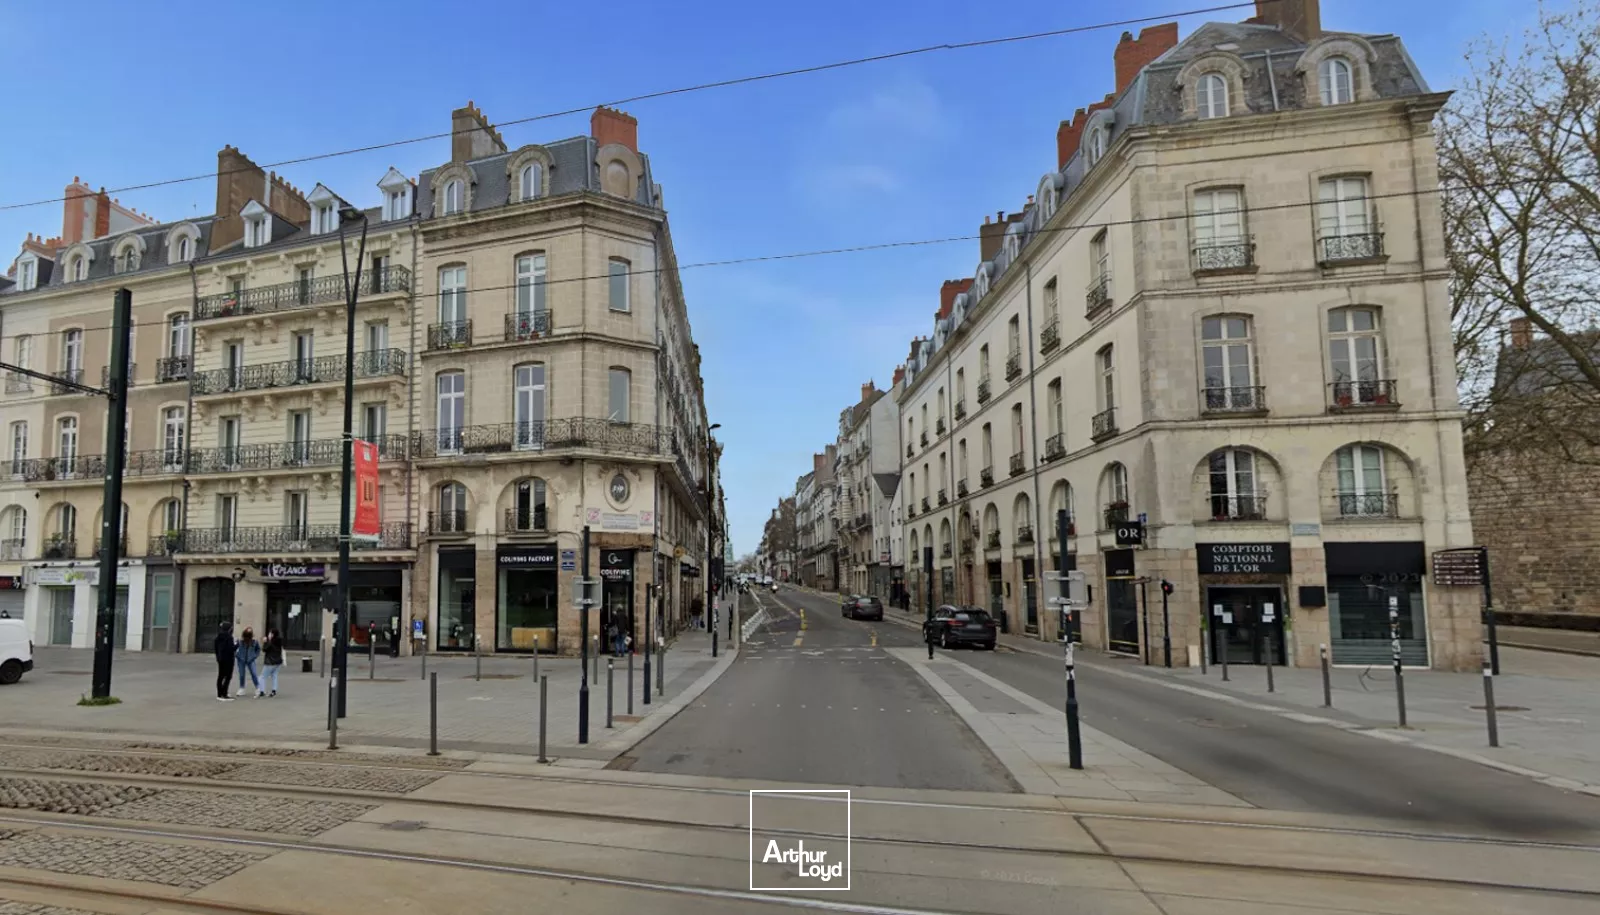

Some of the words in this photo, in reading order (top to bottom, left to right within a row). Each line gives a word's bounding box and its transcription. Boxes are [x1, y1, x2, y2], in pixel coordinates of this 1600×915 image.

[1118, 527, 1139, 539] OR
[1212, 545, 1274, 554] COMPTOIR
[1213, 554, 1275, 564] NATIONAL
[1214, 564, 1230, 573] DE
[1233, 563, 1260, 573] L'OR
